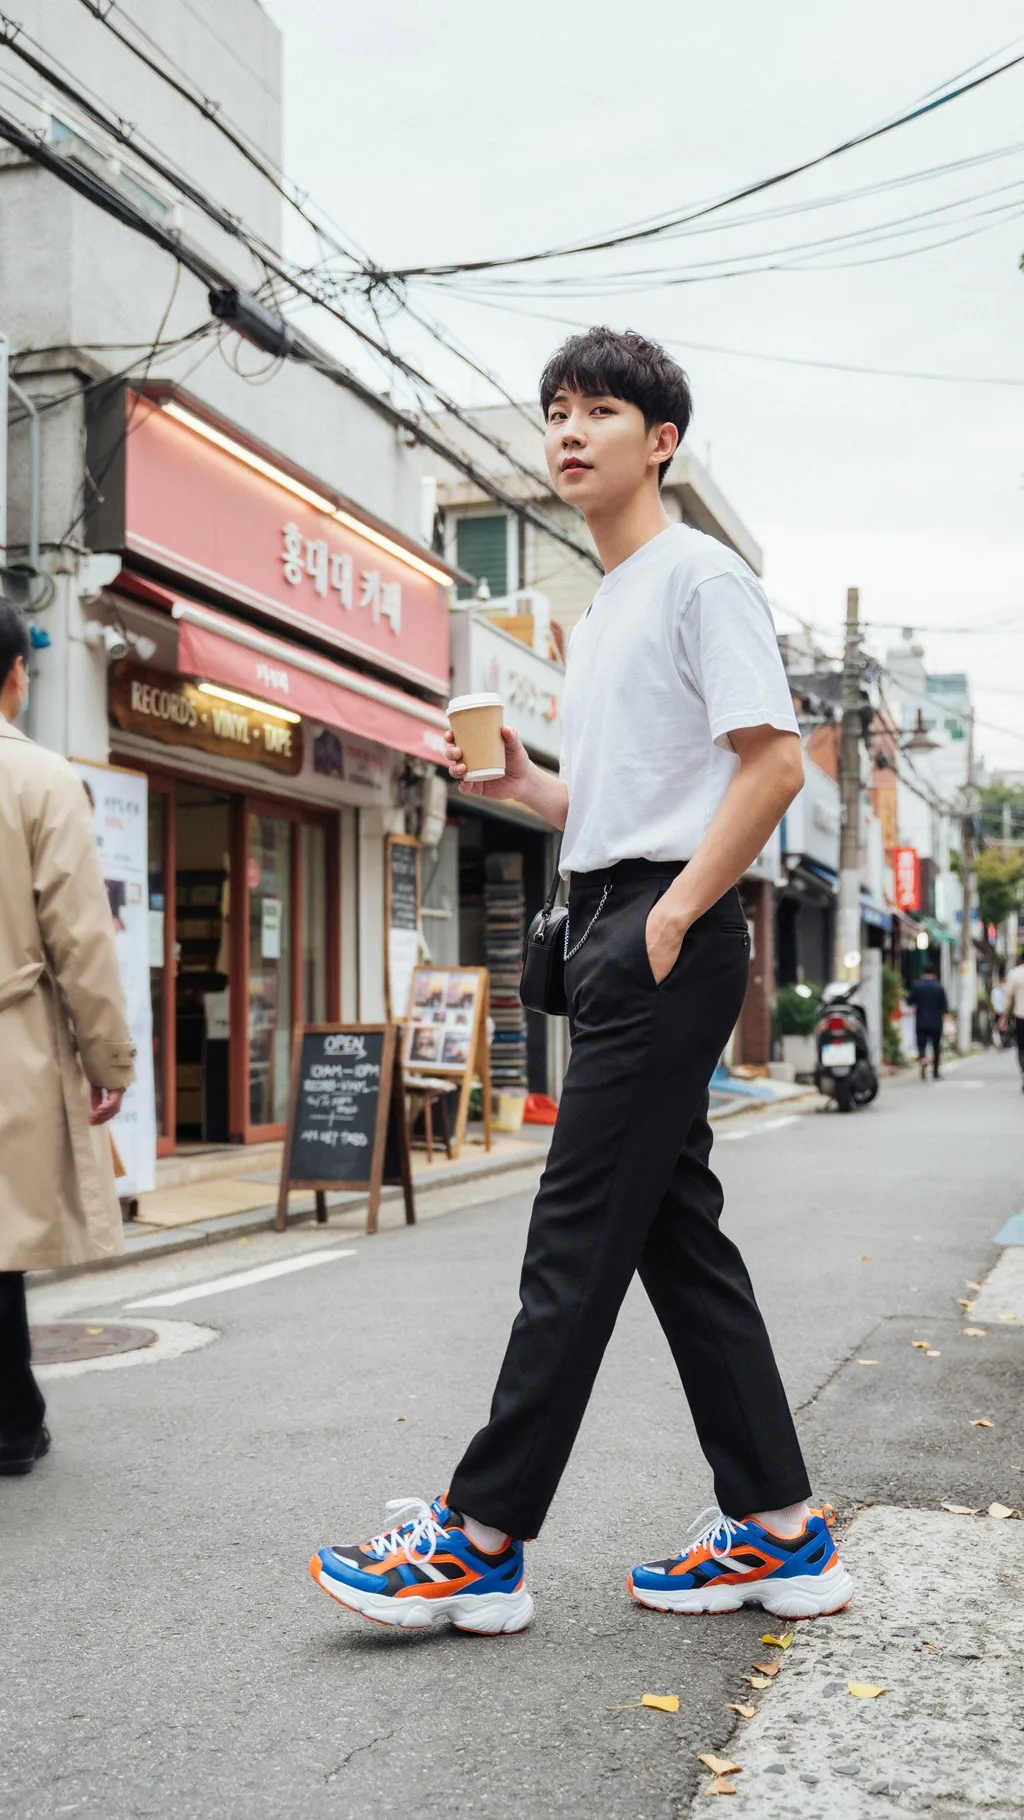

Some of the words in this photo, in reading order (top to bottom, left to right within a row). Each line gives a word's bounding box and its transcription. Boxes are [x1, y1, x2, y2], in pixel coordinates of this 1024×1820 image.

[359, 569, 402, 637] 카페
[131, 680, 198, 728] RECORDS
[211, 708, 250, 745] VINYL
[263, 722, 292, 758] TAPE
[323, 1035, 366, 1053] OPEN
